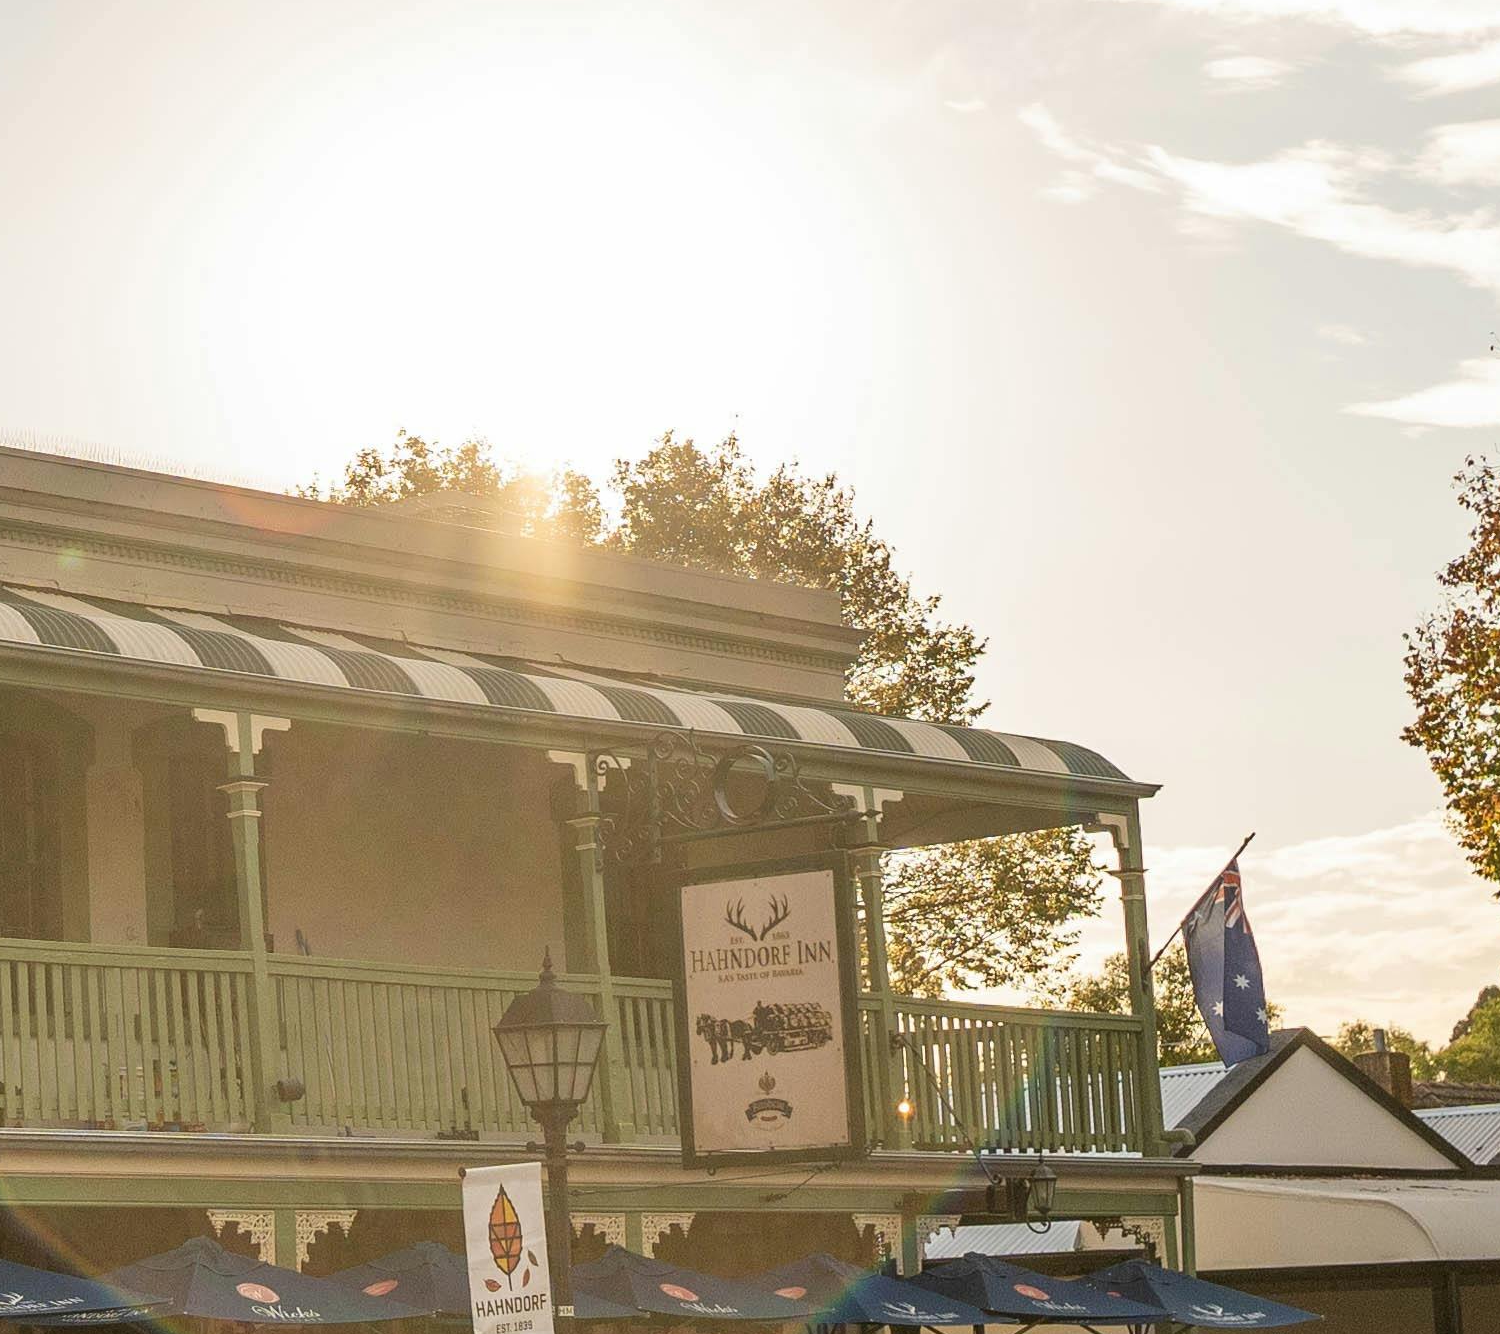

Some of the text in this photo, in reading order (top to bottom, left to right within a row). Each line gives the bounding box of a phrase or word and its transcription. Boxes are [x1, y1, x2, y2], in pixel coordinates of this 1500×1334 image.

[690, 940, 832, 973] HAHNDORF INN
[475, 1293, 548, 1318] HAHNDORF
[496, 1323, 512, 1334] EST.
